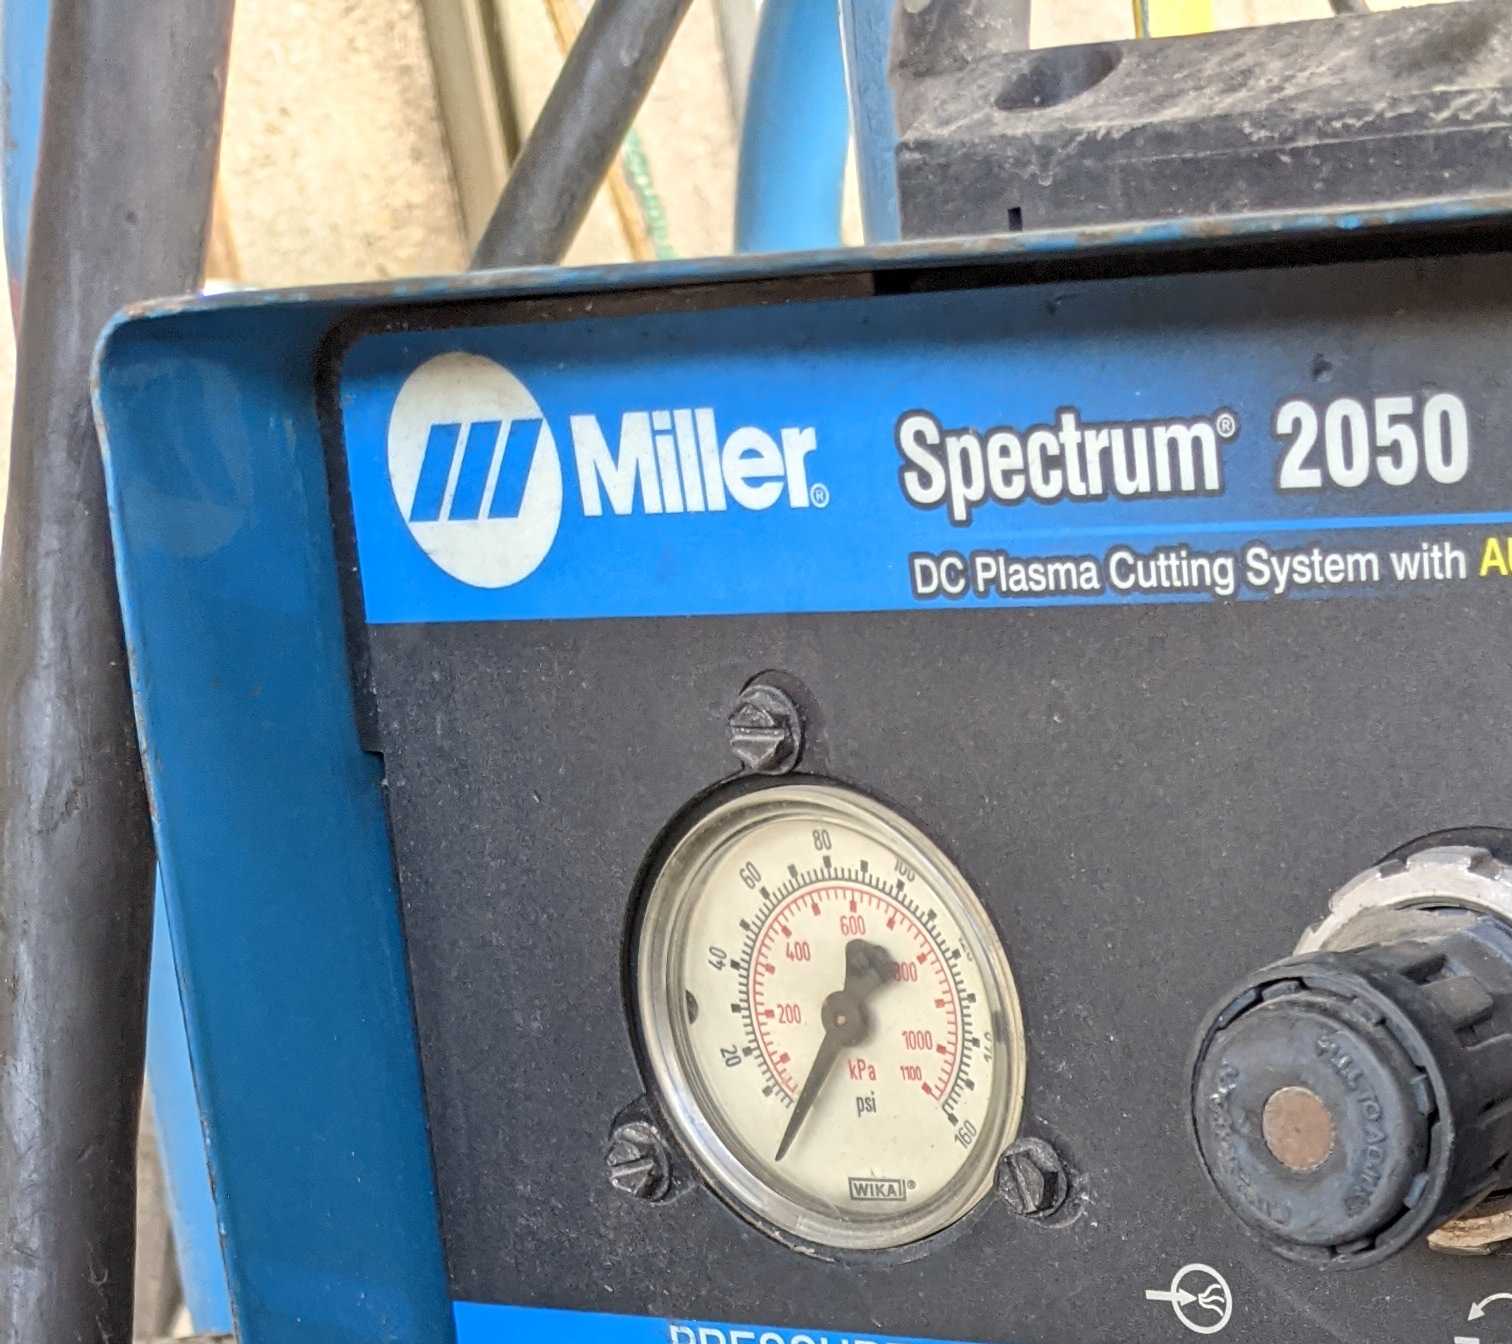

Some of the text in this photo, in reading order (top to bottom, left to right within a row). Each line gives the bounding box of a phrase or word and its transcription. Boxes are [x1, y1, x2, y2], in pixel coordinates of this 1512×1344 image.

[1276, 393, 1469, 489] 2050
[913, 556, 966, 594] DC
[975, 554, 1100, 593] Plasma
[1109, 550, 1235, 597] Cutting
[1246, 547, 1380, 594] System
[1390, 542, 1467, 582] with
[811, 829, 832, 851] 80
[738, 861, 762, 890] 60
[893, 854, 916, 882] 100
[840, 915, 866, 936] 600
[708, 945, 728, 971] 40
[785, 942, 812, 963] 400
[776, 1003, 802, 1025] 200
[901, 1029, 933, 1051] 1000
[720, 1043, 742, 1068] 20
[847, 1057, 877, 1081] kPa
[899, 1065, 923, 1081] 1100
[855, 1089, 877, 1118] psi
[953, 1119, 978, 1150] 160
